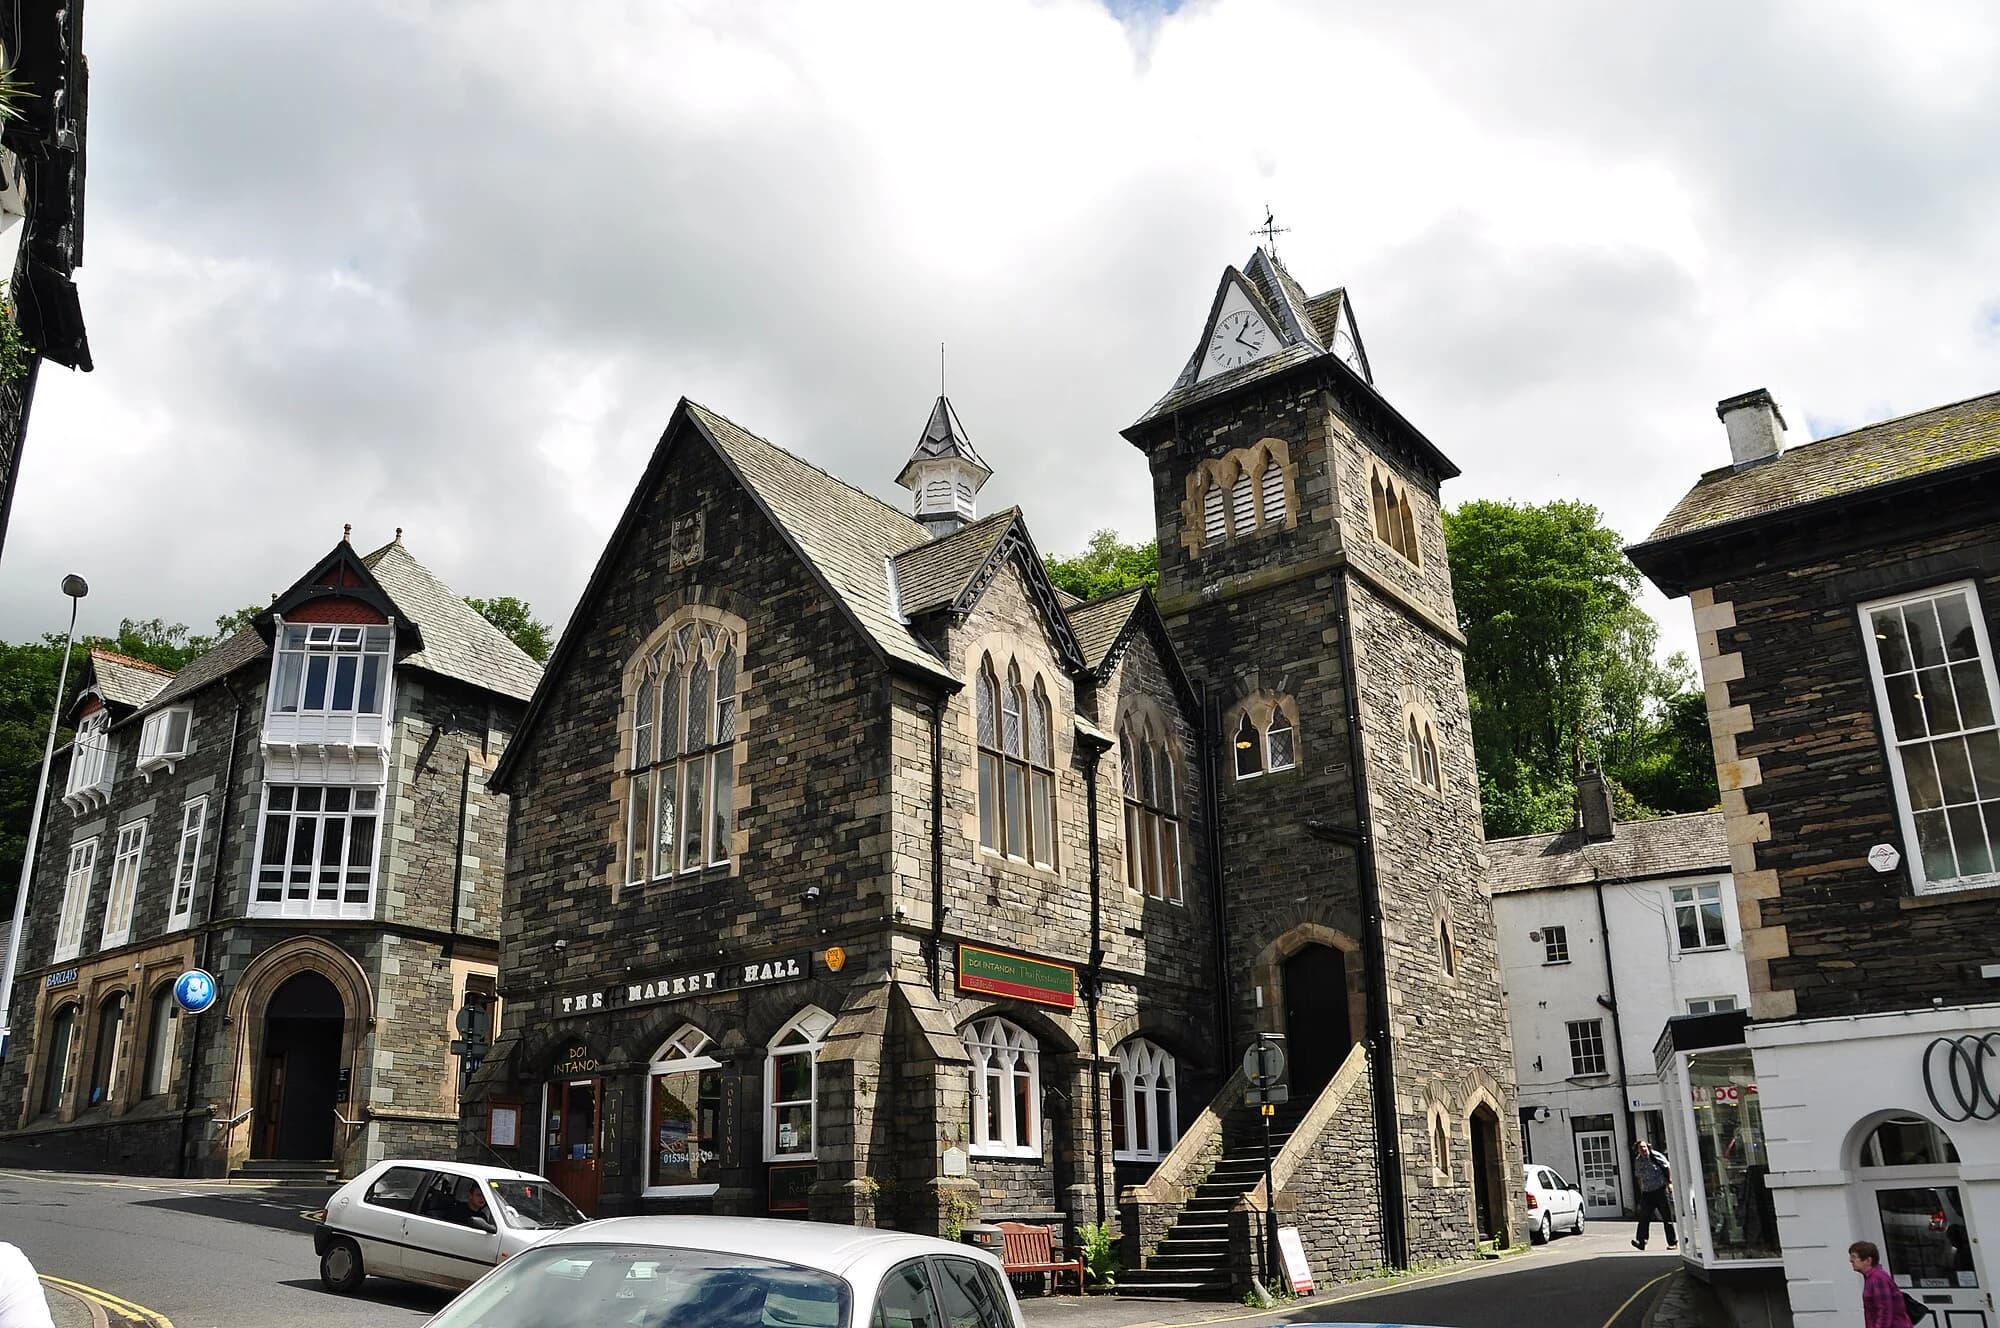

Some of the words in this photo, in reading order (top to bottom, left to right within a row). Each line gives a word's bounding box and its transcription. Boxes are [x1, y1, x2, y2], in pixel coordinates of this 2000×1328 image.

[47, 967, 78, 987] BARCLAYS
[562, 992, 603, 1013] THE
[628, 972, 715, 1002] MARKET
[744, 959, 800, 983] HALL
[569, 1045, 587, 1059] DOI
[608, 1098, 618, 1153] THAI
[726, 1088, 735, 1164] ORIGINAL
